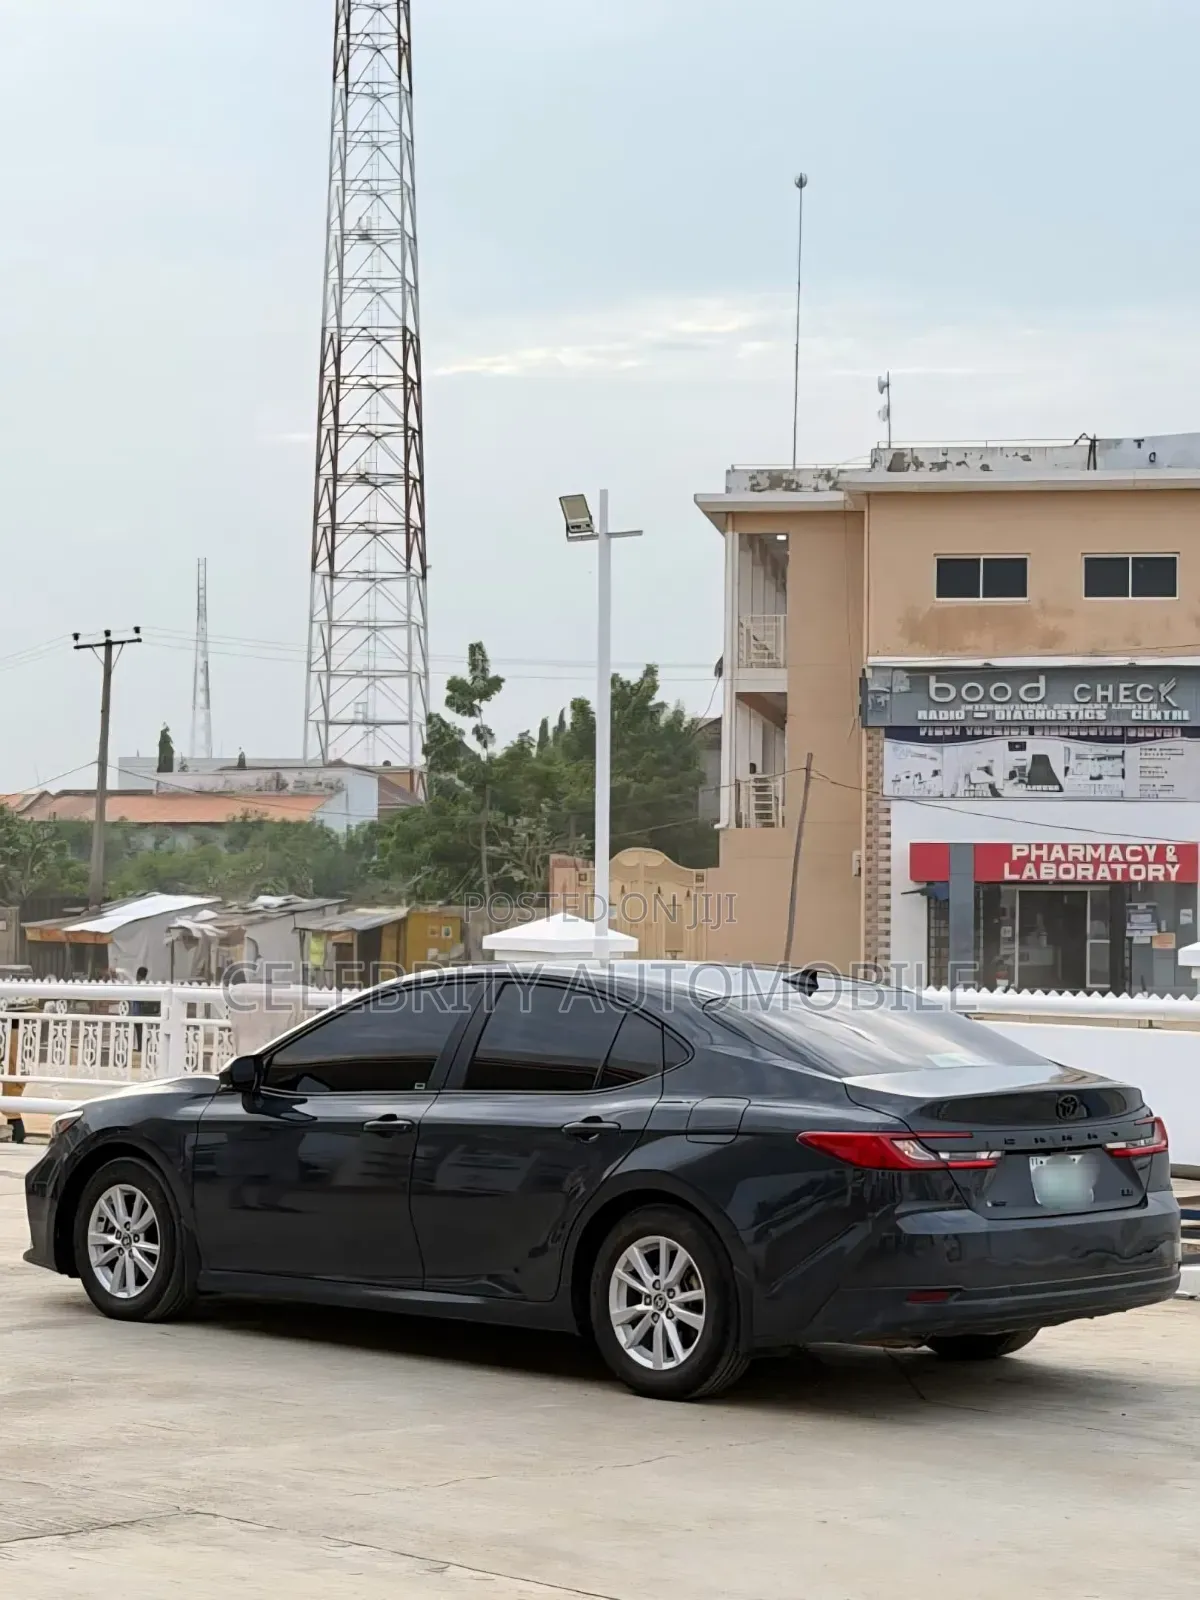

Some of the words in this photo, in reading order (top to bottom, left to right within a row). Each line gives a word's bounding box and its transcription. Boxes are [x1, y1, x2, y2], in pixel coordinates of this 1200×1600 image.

[1073, 676, 1178, 708] CHECK
[917, 709, 966, 721] RADIO
[994, 709, 1107, 721] DIAGNOSTICS
[1011, 844, 1157, 862] PHARMACY
[1165, 845, 1178, 863] &
[1003, 861, 1181, 881] LABORATORY
